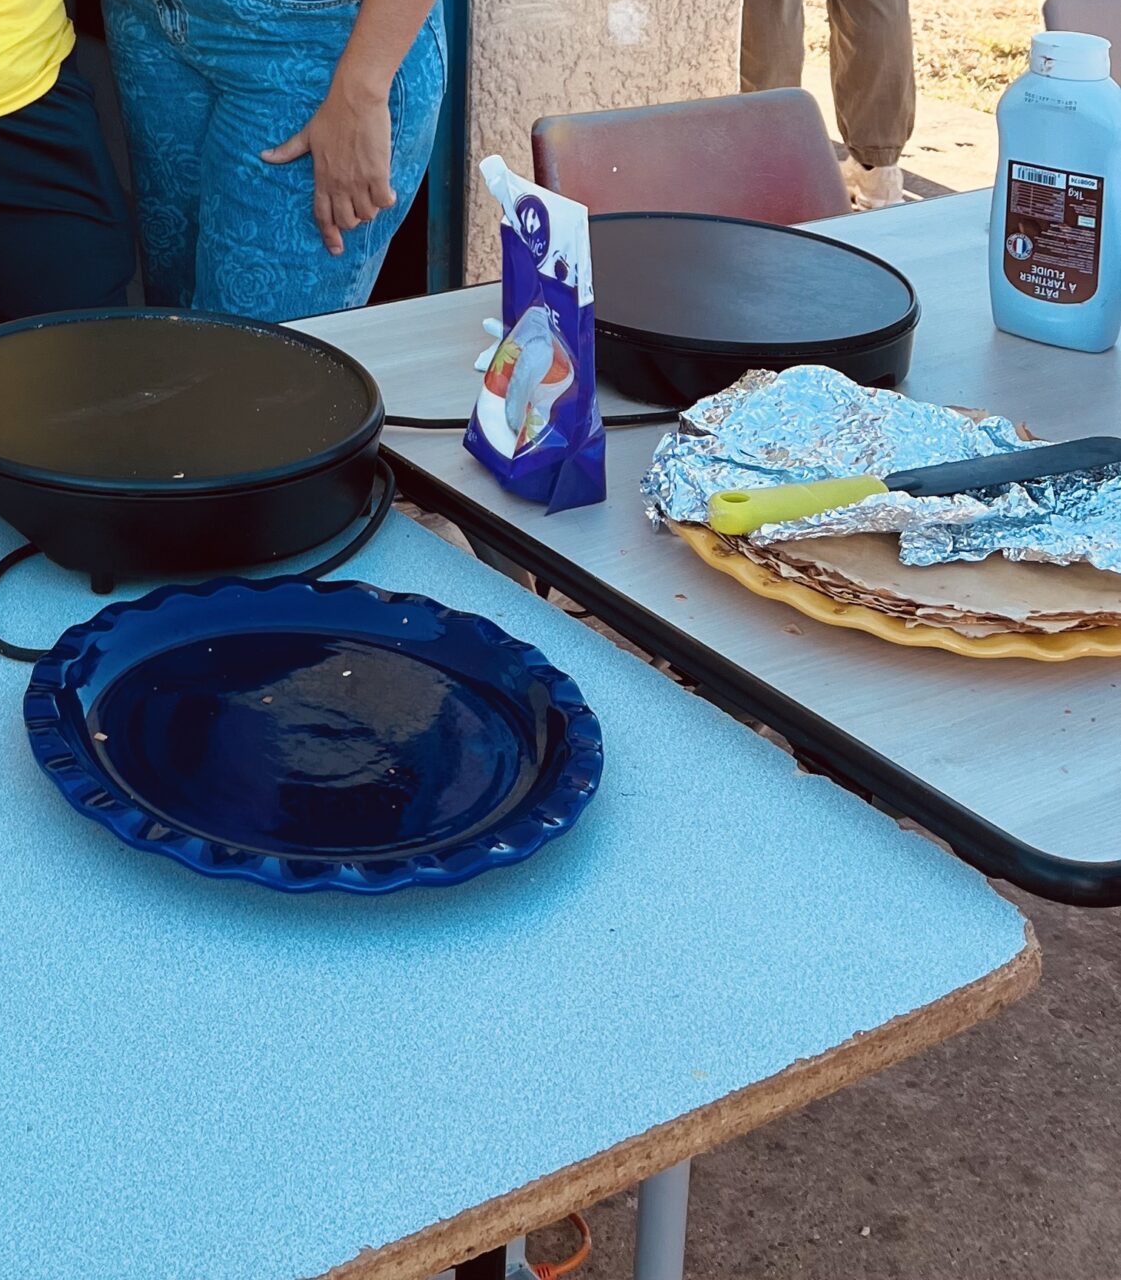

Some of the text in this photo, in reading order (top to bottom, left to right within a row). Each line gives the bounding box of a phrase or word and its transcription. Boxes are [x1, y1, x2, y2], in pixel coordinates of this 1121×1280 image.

[1068, 187, 1085, 201] 1kg
[1031, 264, 1066, 280] FLUIDE
[1019, 271, 1067, 291] TARTINER
